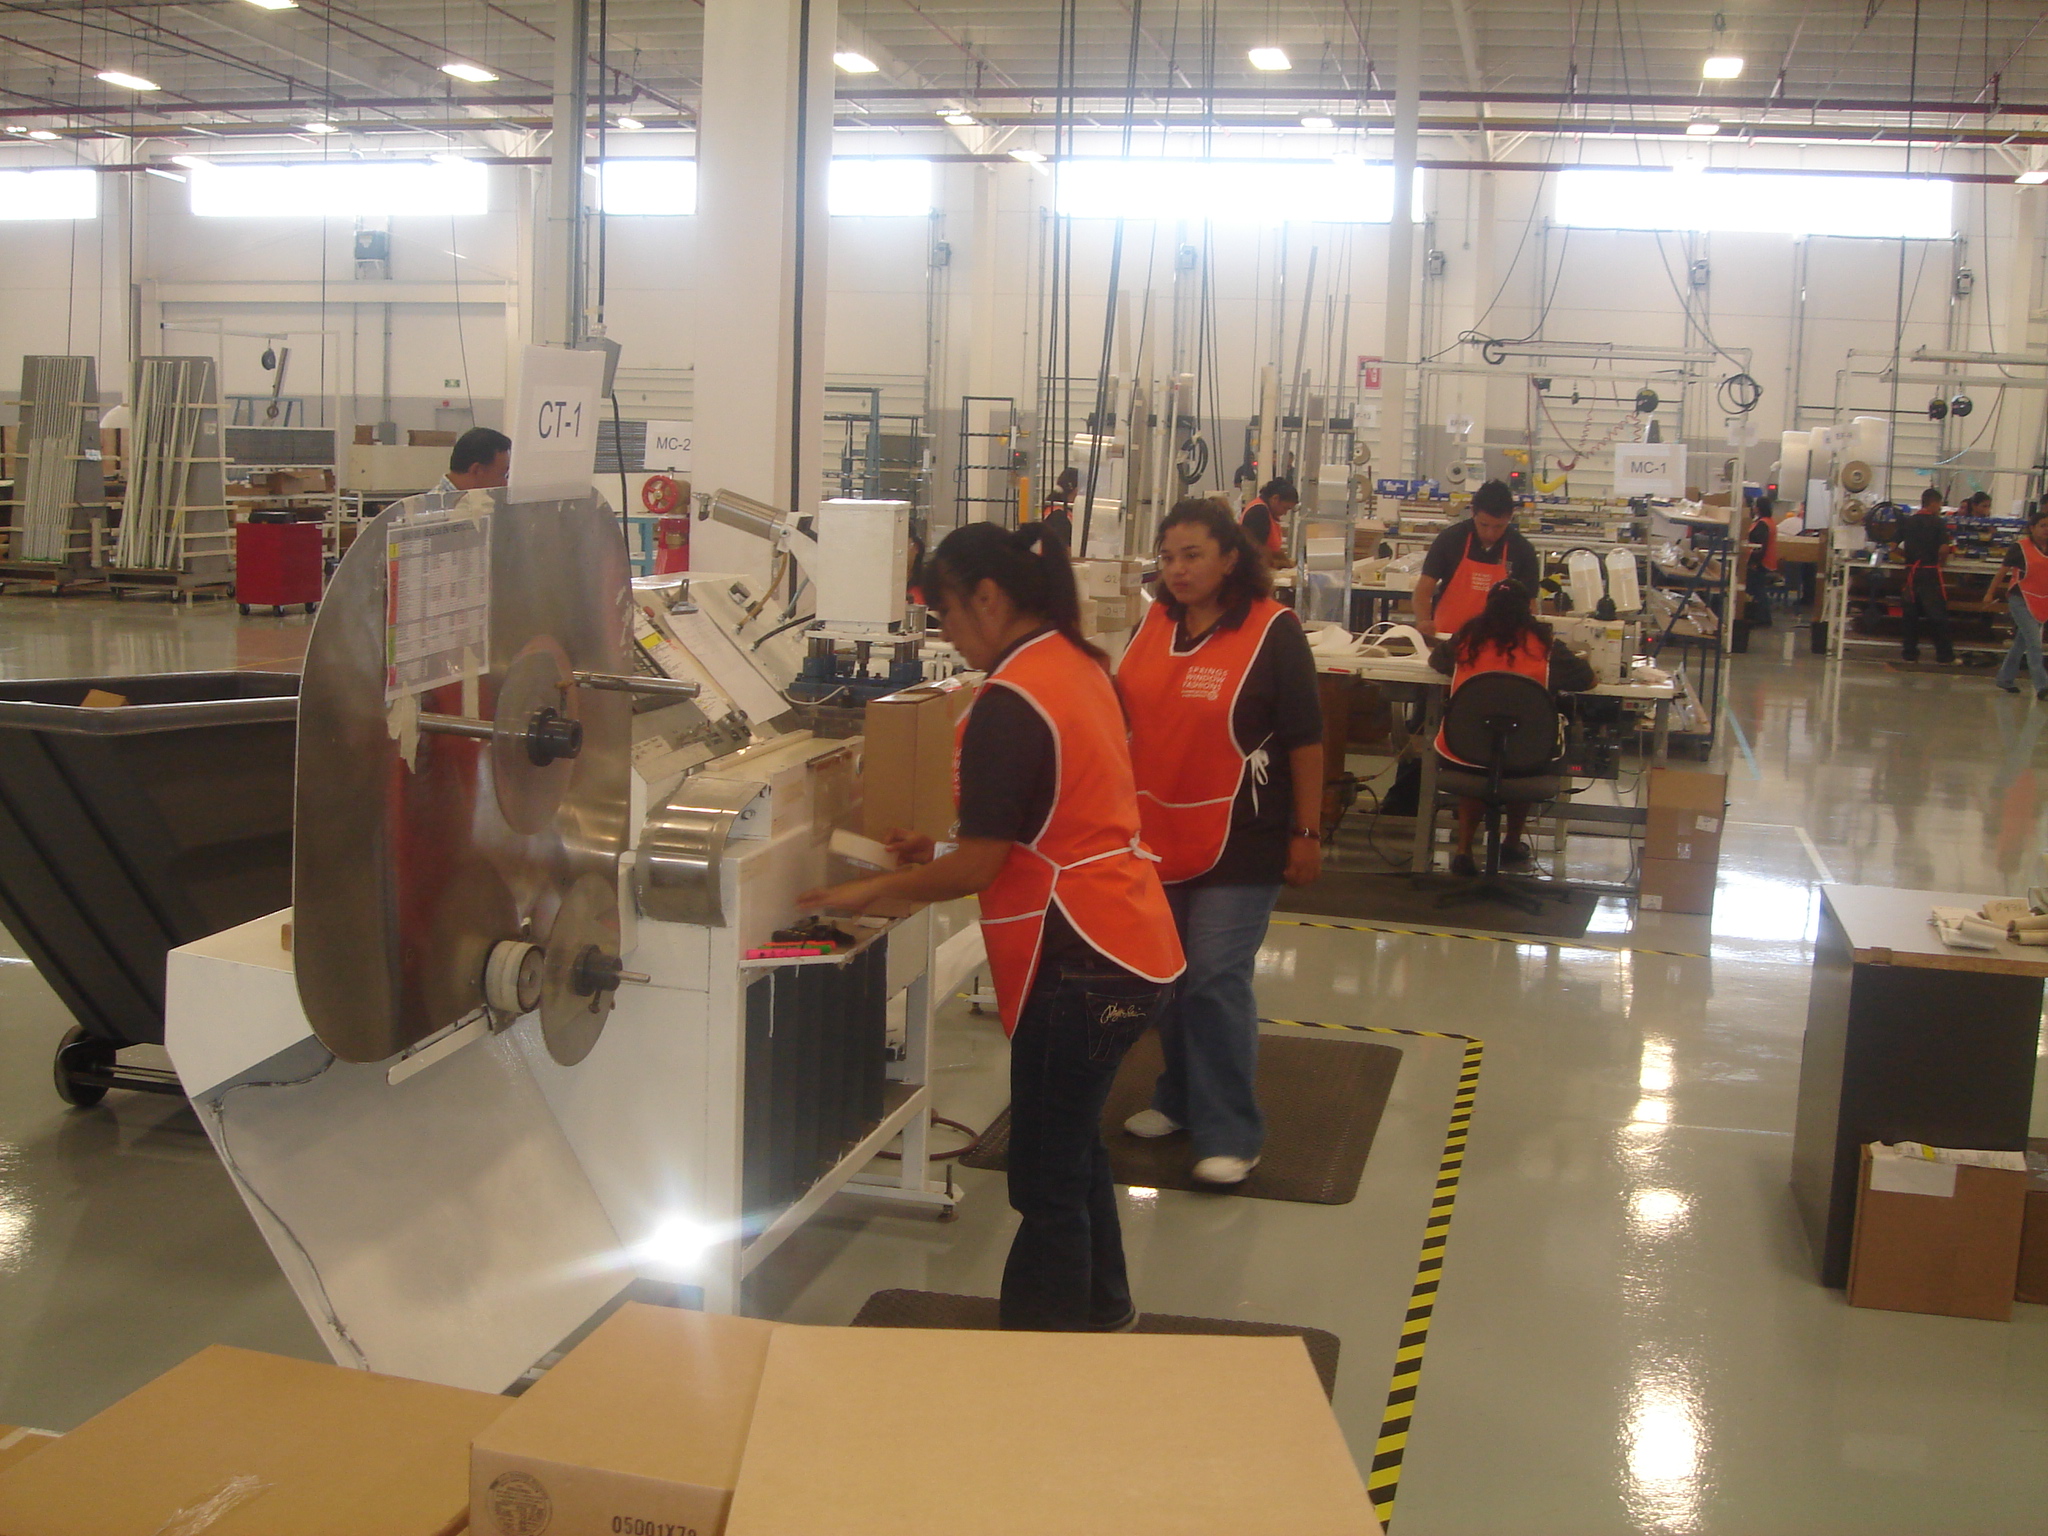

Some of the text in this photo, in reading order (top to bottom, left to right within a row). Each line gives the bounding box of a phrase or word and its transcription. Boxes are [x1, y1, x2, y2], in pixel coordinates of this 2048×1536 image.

[538, 400, 582, 439] CT-1
[656, 436, 691, 451] MC-2
[1630, 461, 1667, 475] MC-1
